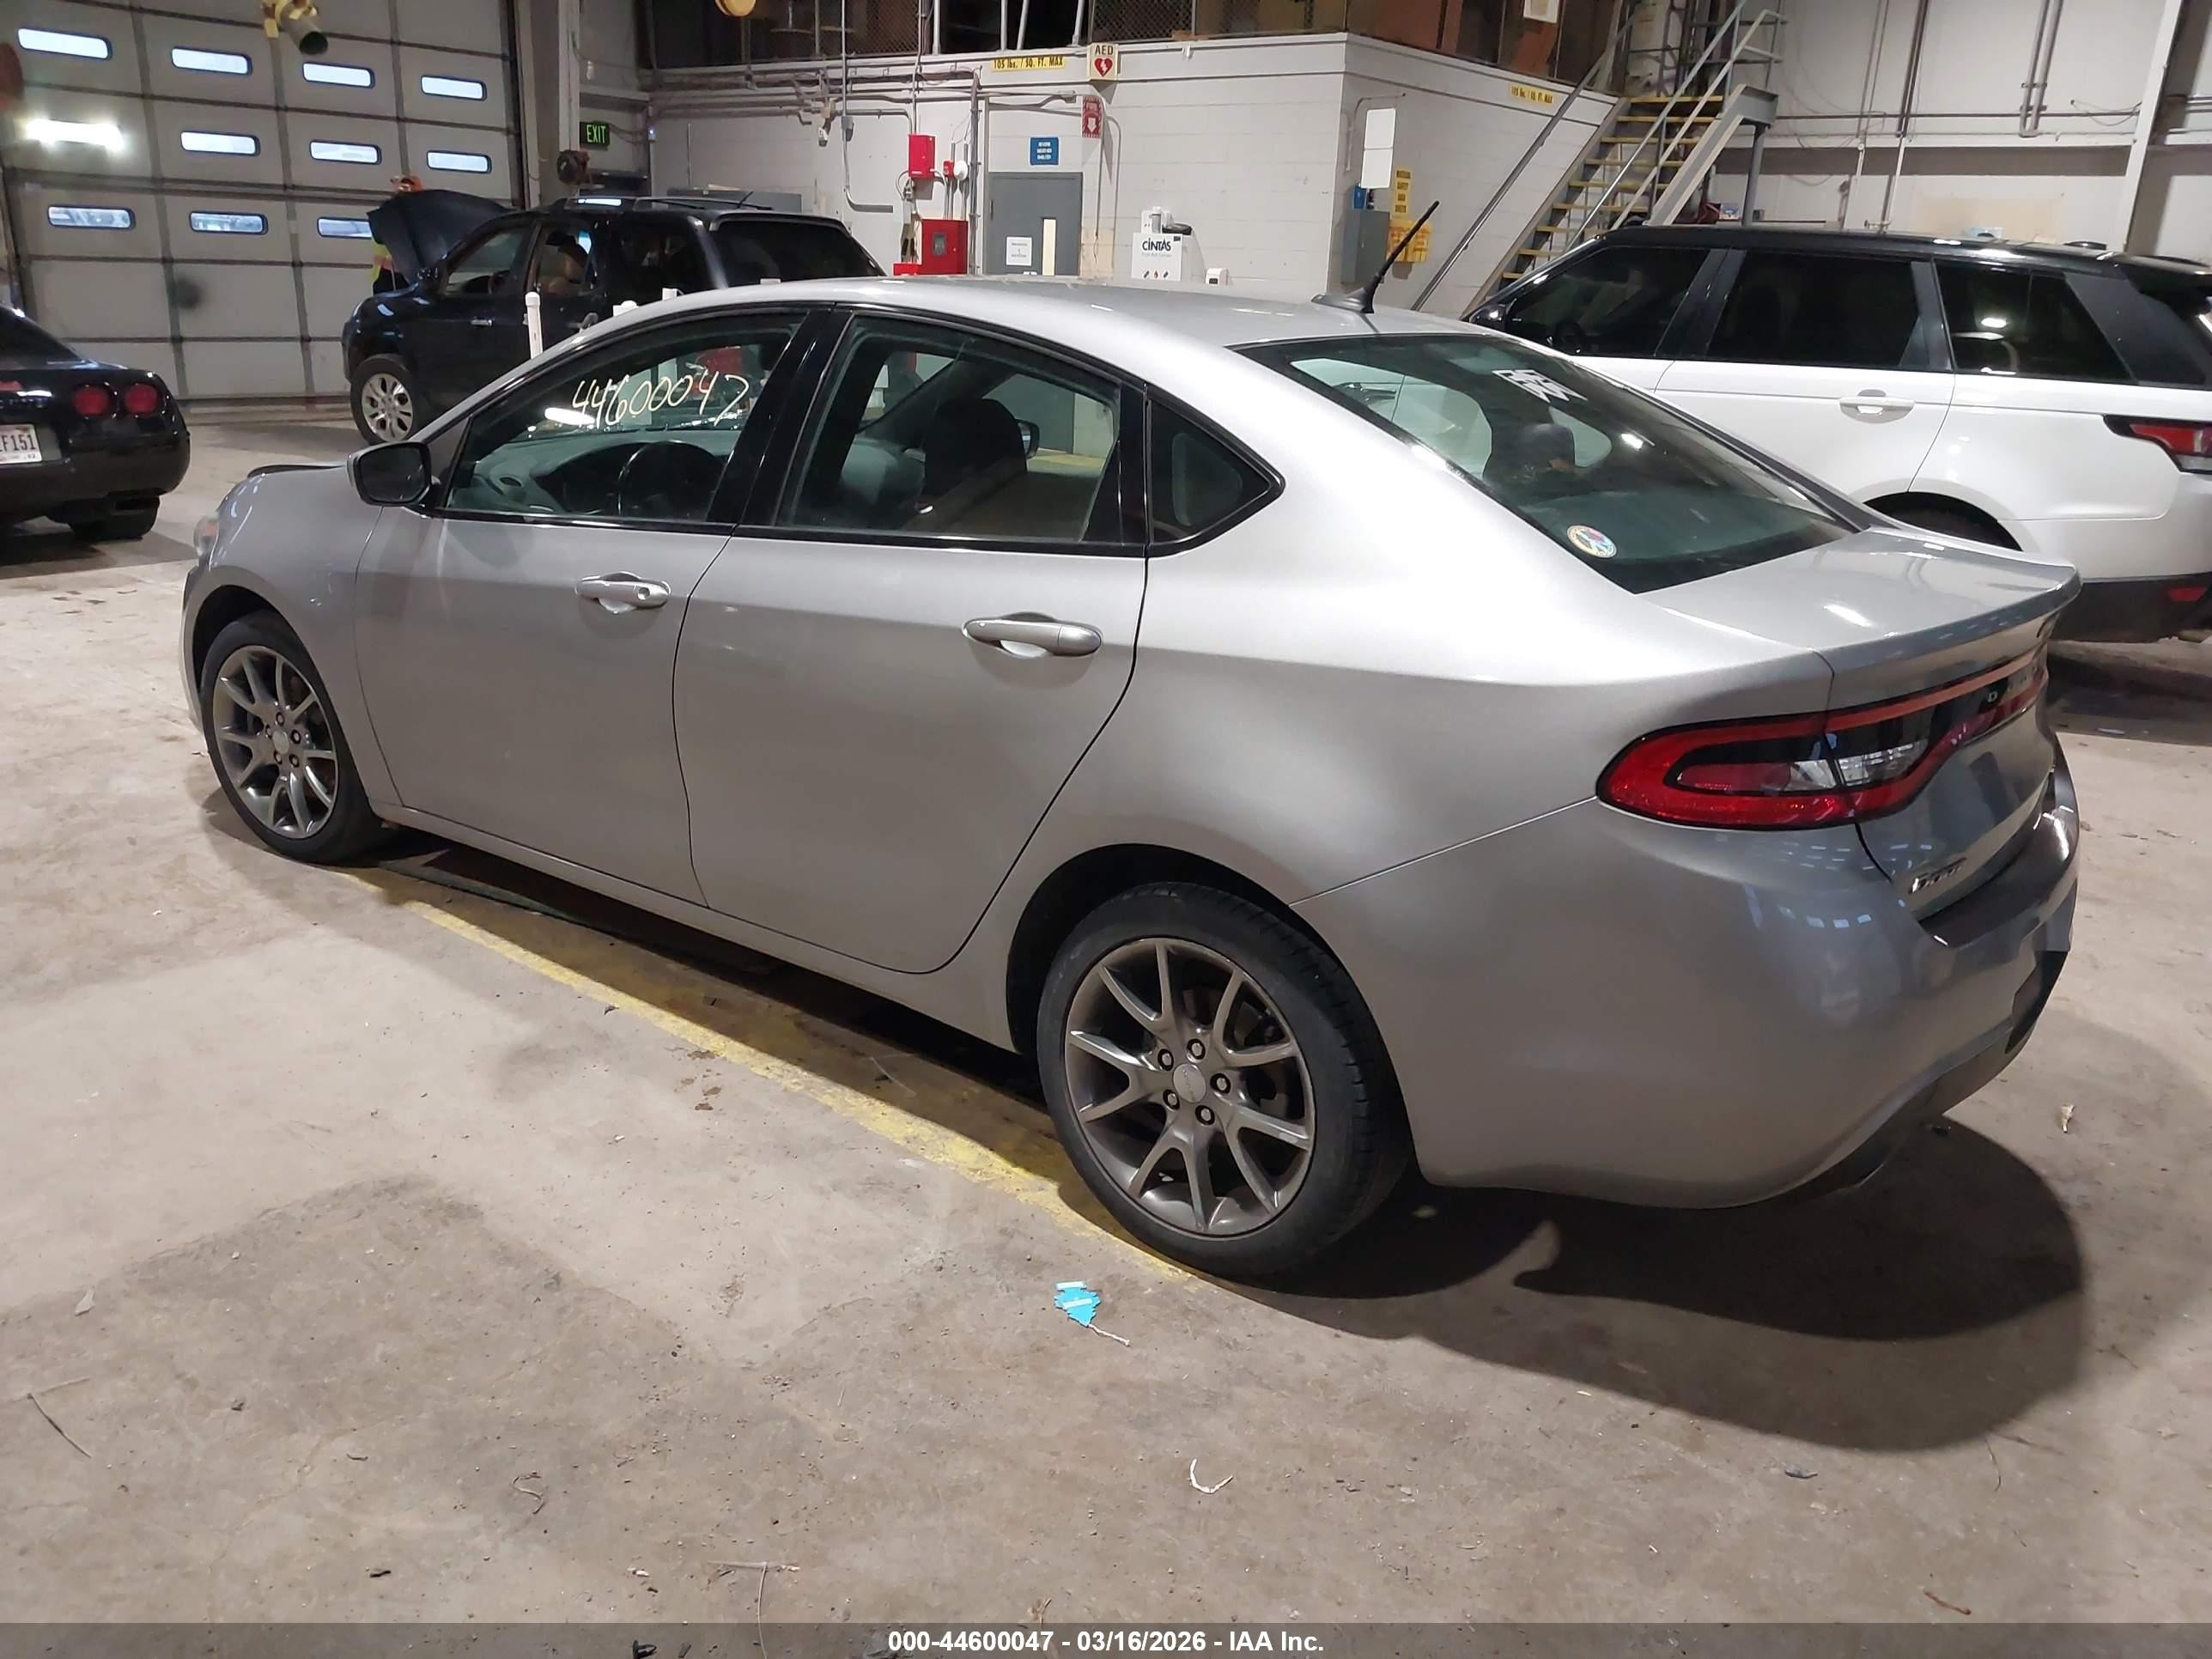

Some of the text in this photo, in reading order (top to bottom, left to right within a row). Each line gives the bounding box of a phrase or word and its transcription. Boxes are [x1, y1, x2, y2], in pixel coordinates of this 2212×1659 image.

[1095, 45, 1114, 55] AED
[994, 58, 1005, 70] 105
[1026, 57, 1036, 68] SQ.
[1038, 57, 1047, 67] FT.
[1049, 55, 1063, 66] MAX
[586, 124, 606, 144] EXIT
[1142, 237, 1171, 252] CINTAS
[572, 370, 749, 429] 44600047
